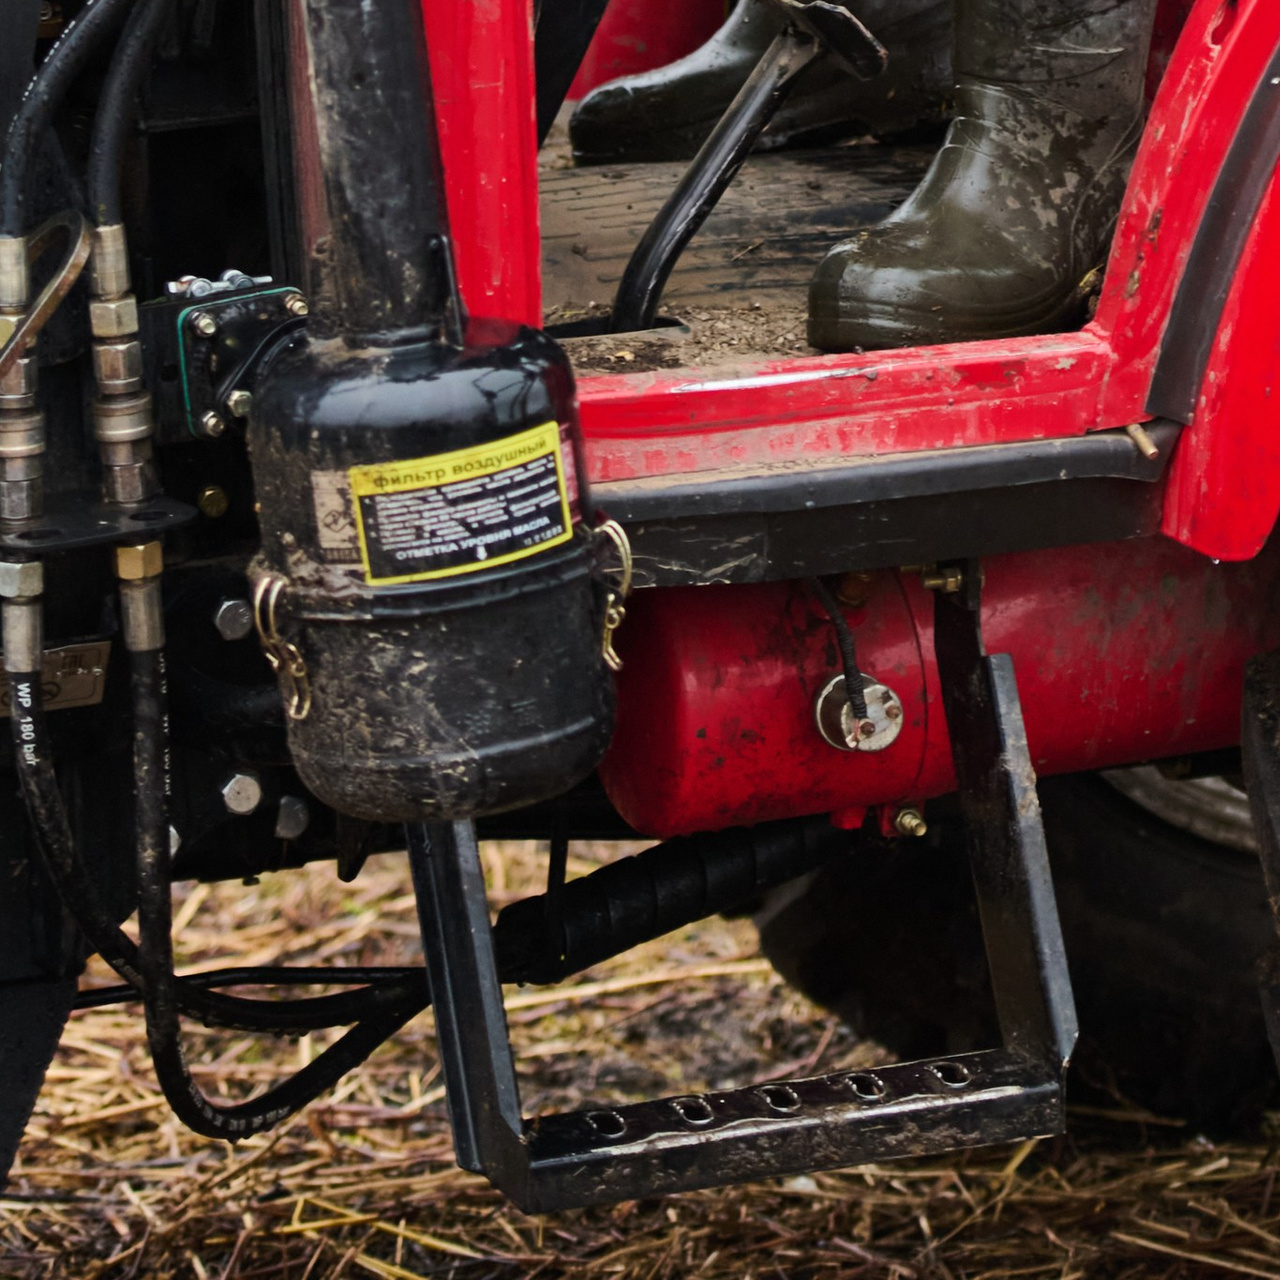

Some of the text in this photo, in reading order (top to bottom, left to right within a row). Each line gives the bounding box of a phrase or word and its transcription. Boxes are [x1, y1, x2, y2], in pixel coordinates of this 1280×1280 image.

[452, 437, 547, 473] воздушный
[395, 541, 460, 561] ОТМЕТКА
[459, 527, 513, 551] УРОВНЯ
[512, 516, 552, 540] МАСЛА
[17, 682, 39, 767] WP 180 bar
